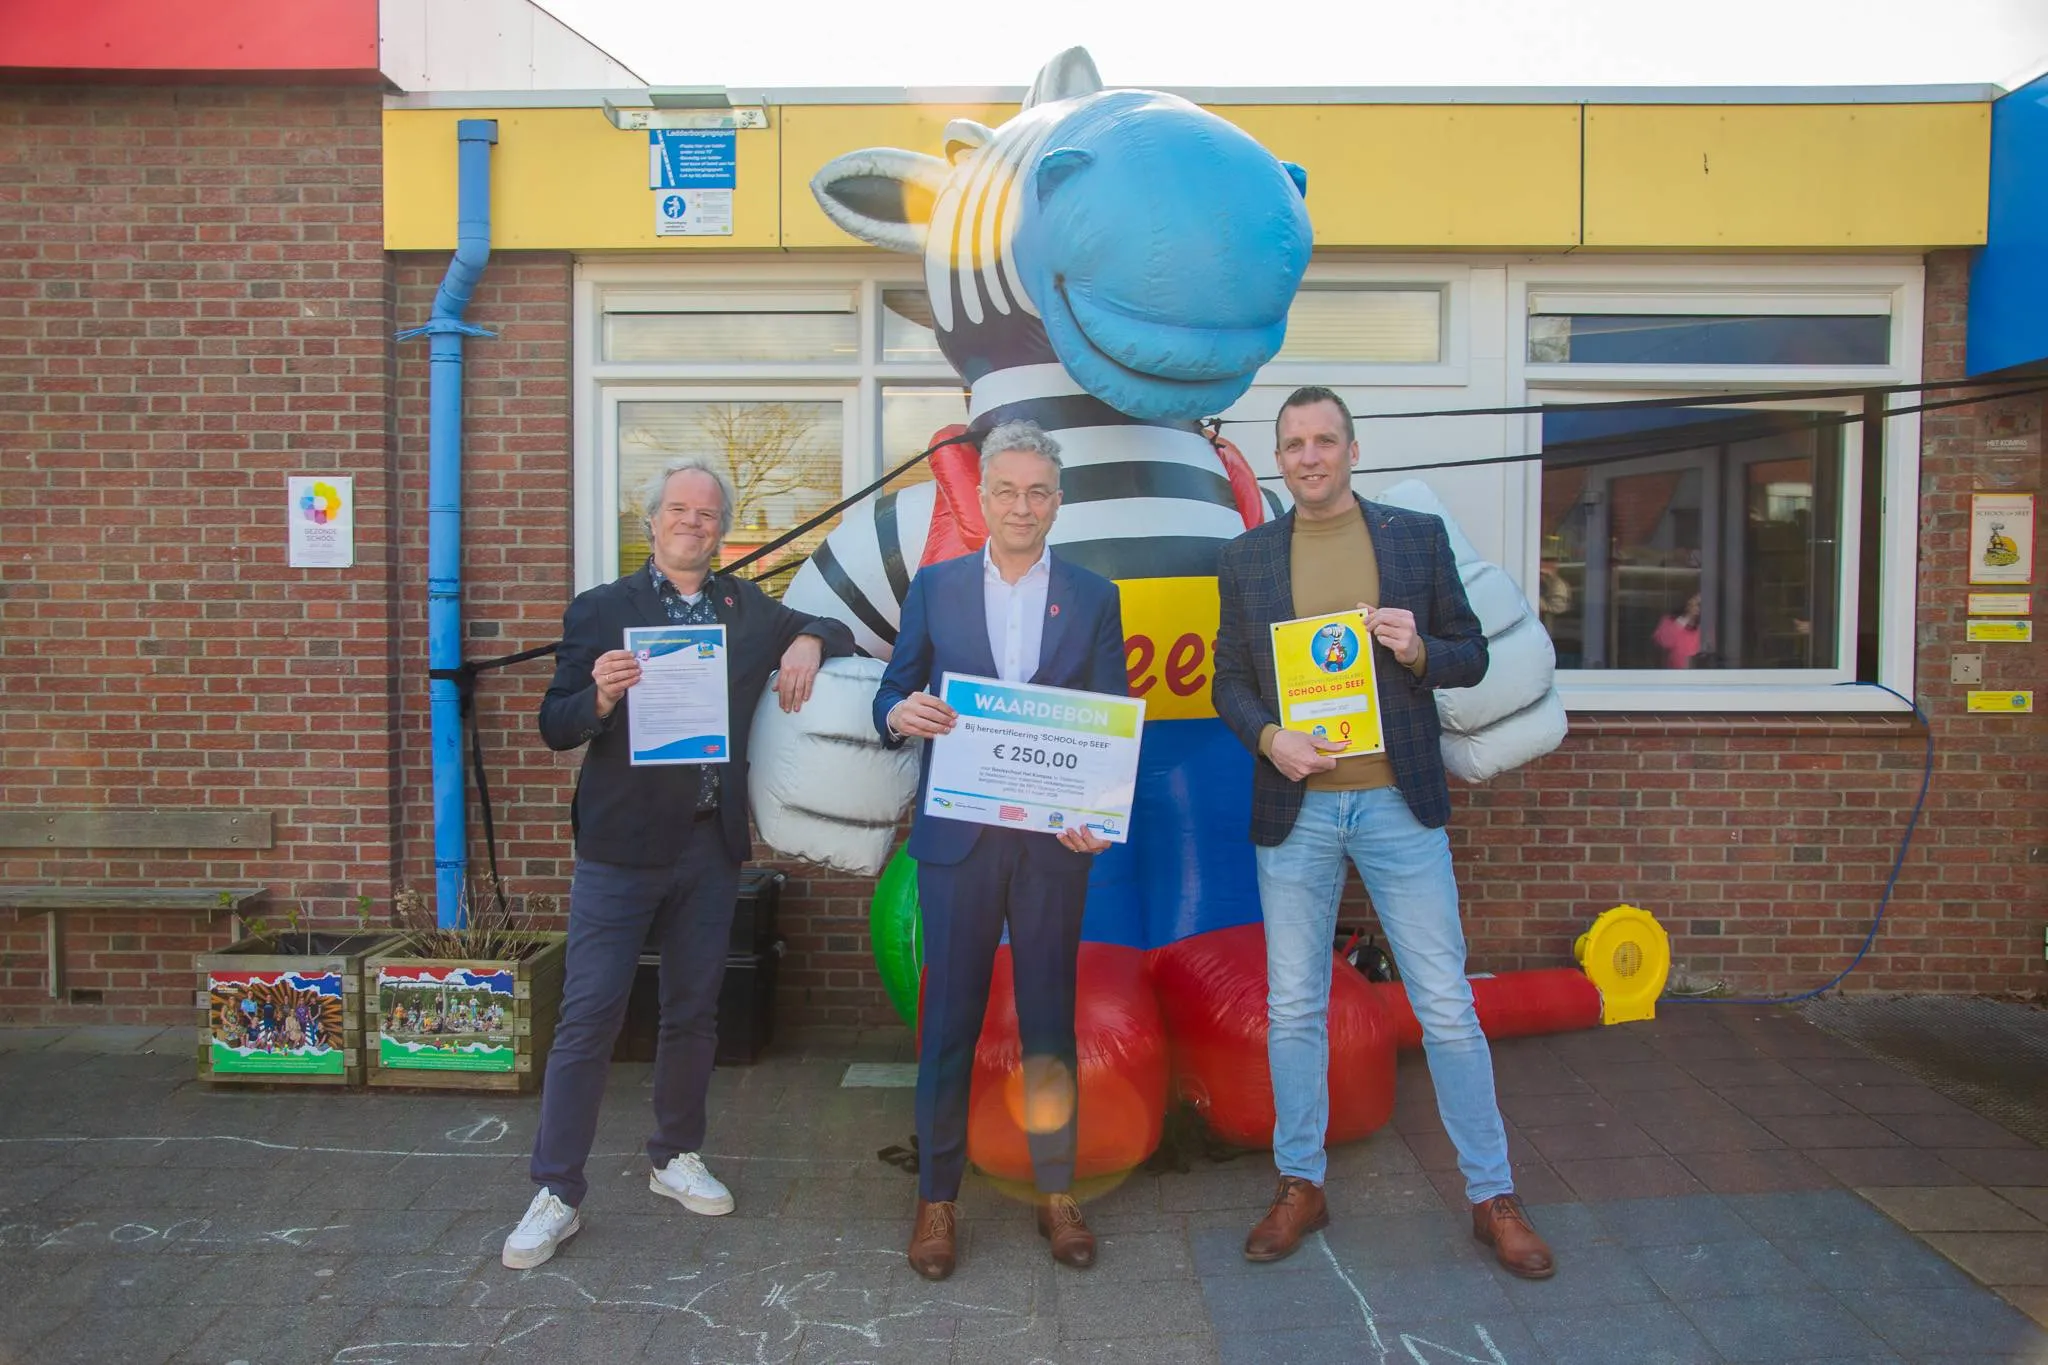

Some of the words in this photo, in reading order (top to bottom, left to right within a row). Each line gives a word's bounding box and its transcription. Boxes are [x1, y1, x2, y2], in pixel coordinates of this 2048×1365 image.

[1124, 633, 1217, 697] ee
[1288, 685, 1327, 697] SCHOOL
[1330, 684, 1343, 692] op
[1345, 679, 1365, 689] SEEF
[974, 692, 1109, 727] WAARDEBON
[965, 723, 976, 733] Bij
[976, 726, 1039, 742] hercertificering
[1078, 740, 1089, 748] op
[992, 744, 1006, 760] €
[1011, 746, 1078, 769] 250,00
